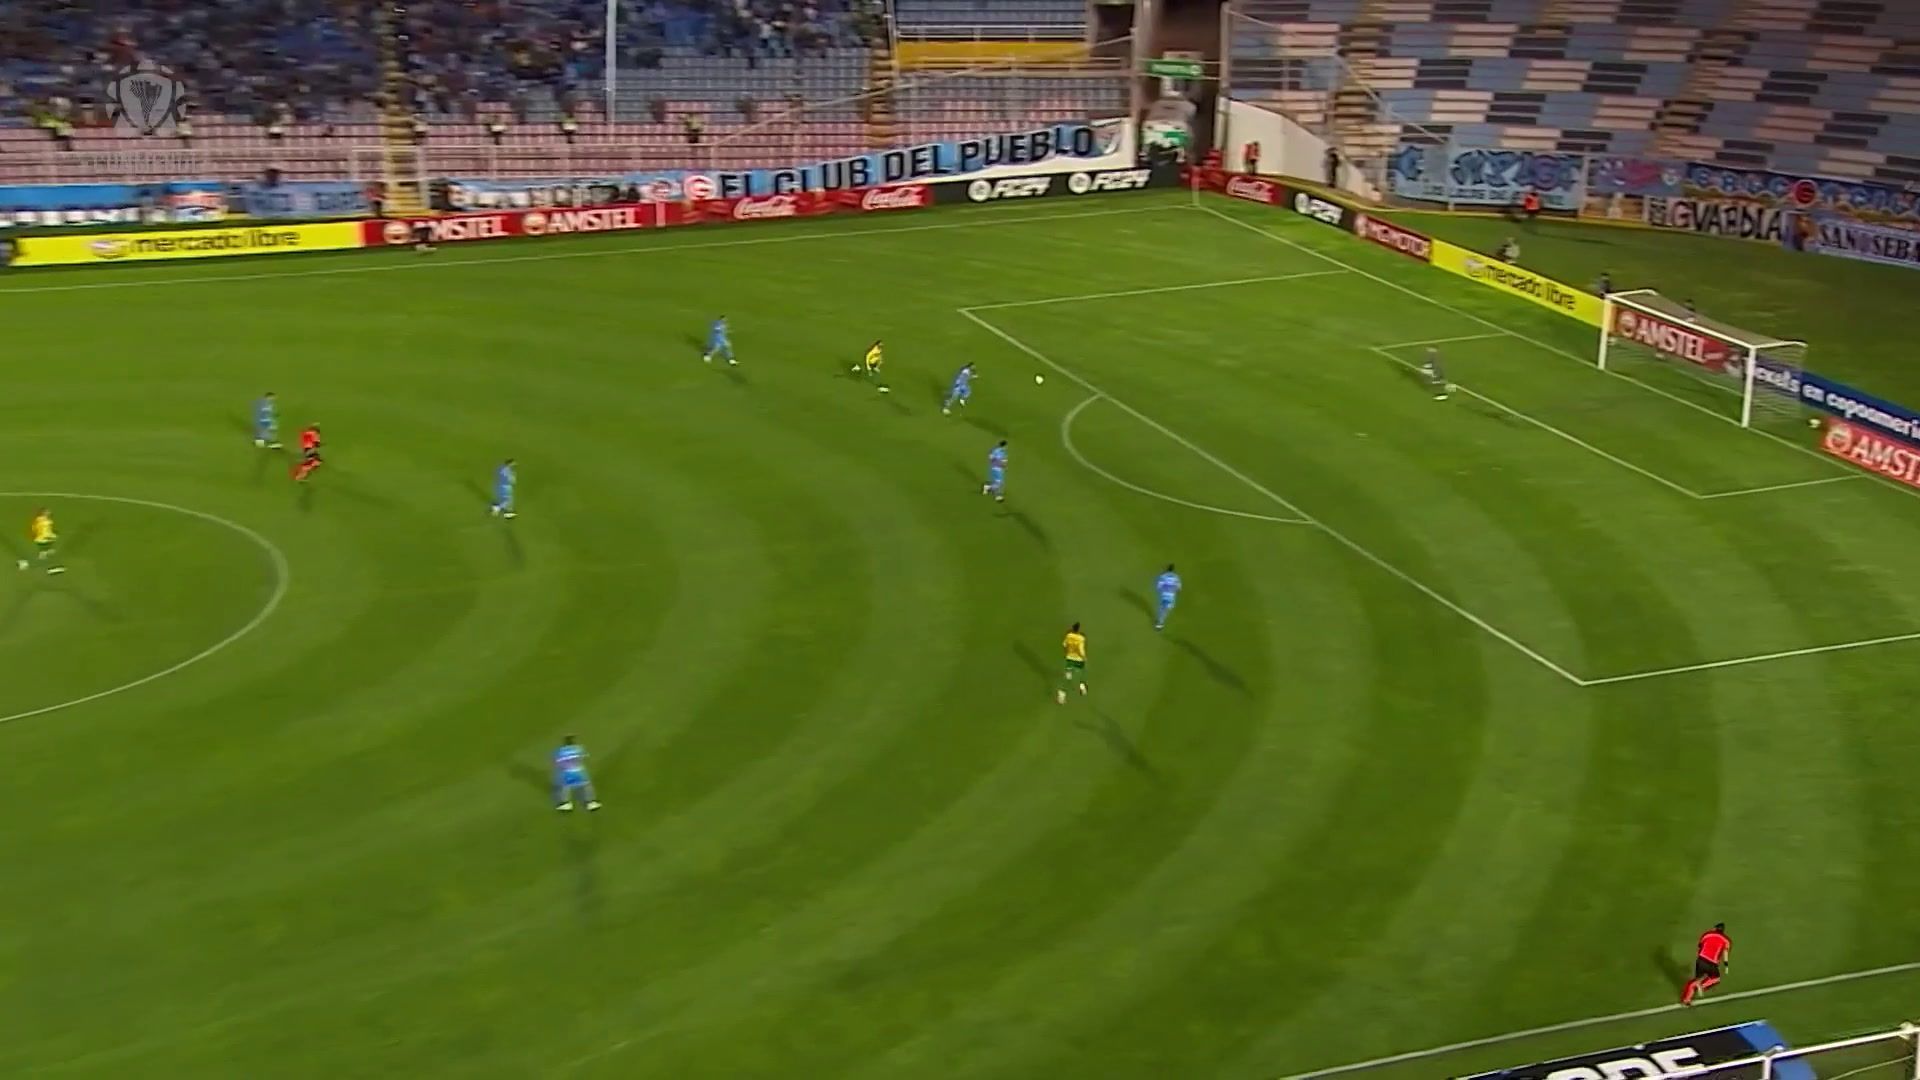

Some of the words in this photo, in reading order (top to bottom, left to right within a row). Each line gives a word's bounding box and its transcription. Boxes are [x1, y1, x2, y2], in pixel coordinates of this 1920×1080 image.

[774, 156, 869, 195] CLUB
[884, 144, 954, 182] DEL
[960, 126, 1094, 172] PUEBLO
[992, 176, 1051, 199] FC24
[1091, 169, 1151, 192] FC24
[546, 207, 643, 234] AMSTEL
[131, 231, 244, 253] mercado
[247, 229, 300, 248] libre
[1486, 264, 1541, 298] mercado
[1545, 281, 1576, 311] libre
[1635, 319, 1708, 364] AMSTEL
[1851, 435, 1920, 484] AMST
